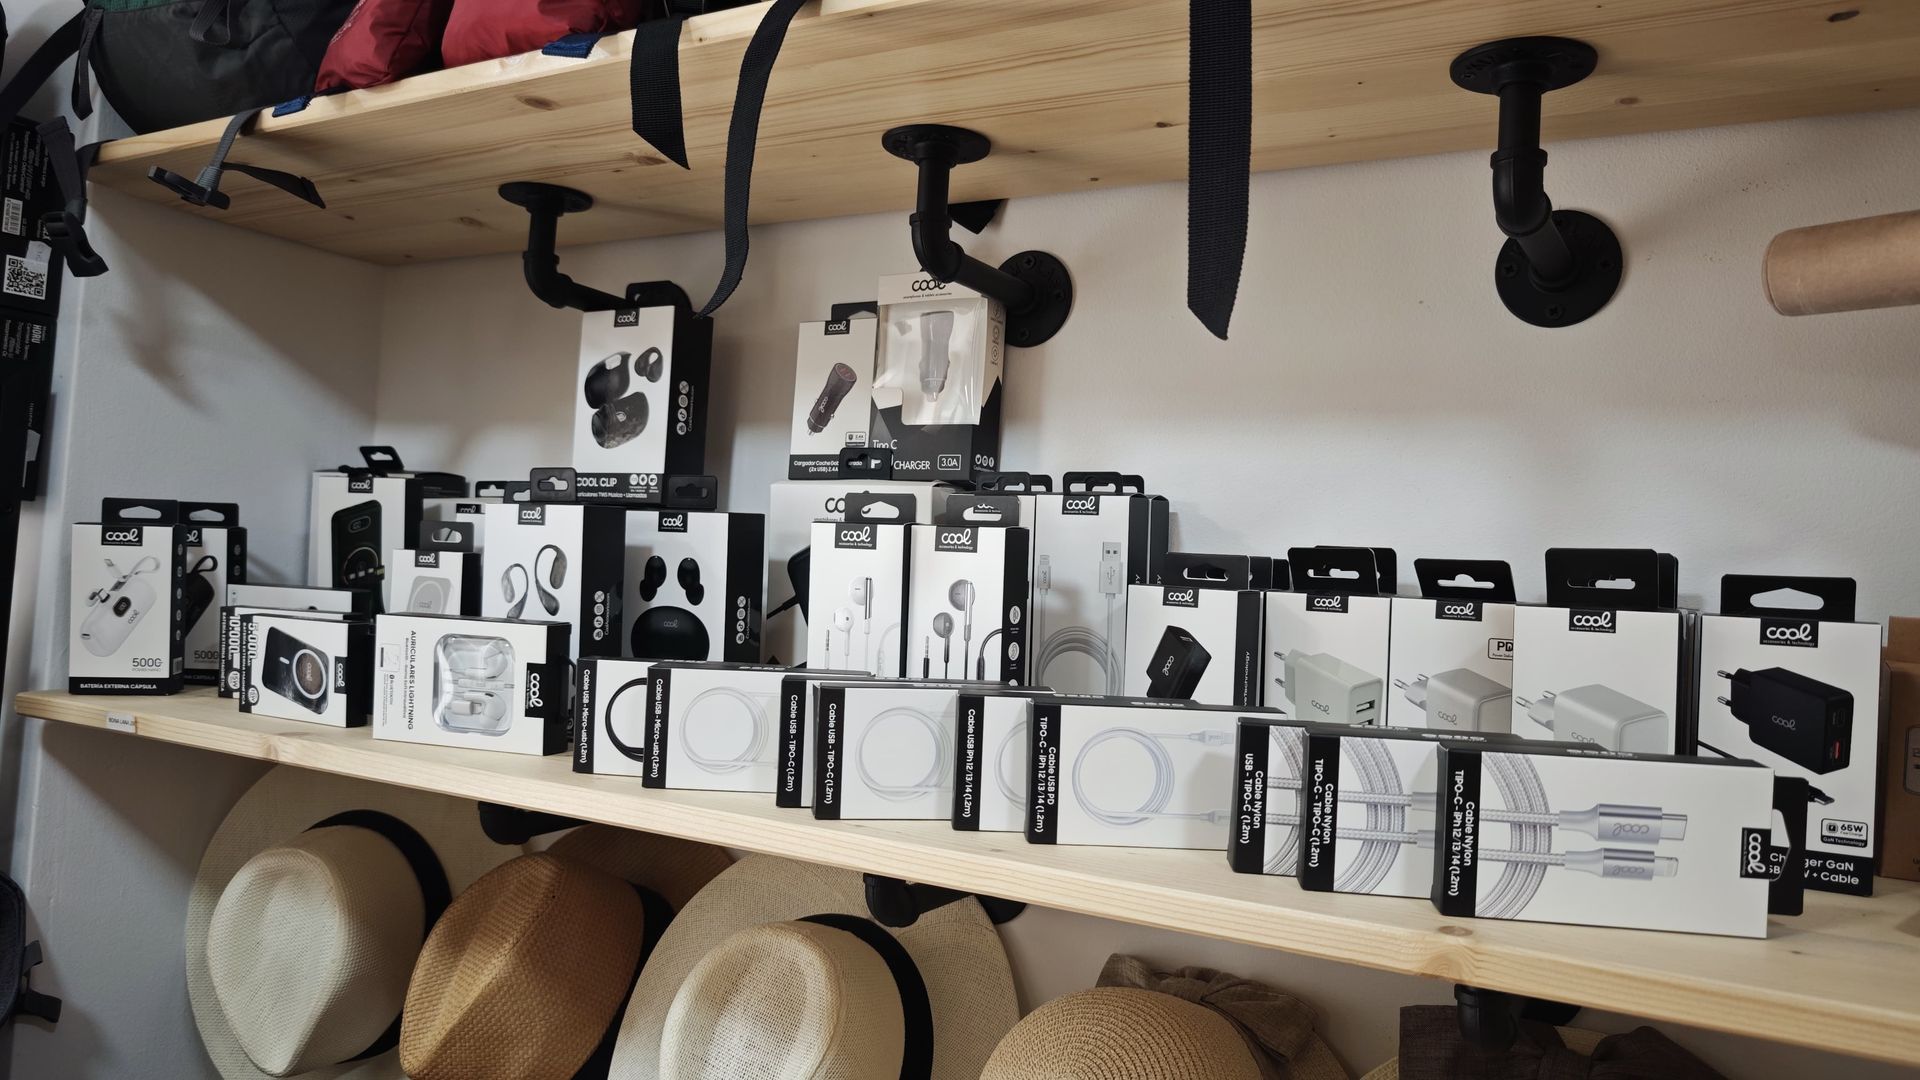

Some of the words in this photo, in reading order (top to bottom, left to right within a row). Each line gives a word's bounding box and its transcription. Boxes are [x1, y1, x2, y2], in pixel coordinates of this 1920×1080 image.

[617, 312, 637, 324] cool
[827, 320, 847, 332] cool
[893, 460, 930, 470] CHARGER
[941, 457, 958, 467] 3.0A
[351, 479, 371, 490] cool
[600, 477, 618, 487] CLIP
[521, 507, 542, 519] cool
[1066, 496, 1095, 510] cool
[662, 514, 684, 527] cool
[105, 528, 139, 542] cool
[841, 526, 871, 542] cool
[941, 528, 972, 545] cool
[418, 552, 436, 564] cool
[1168, 589, 1194, 602] cool
[1314, 595, 1341, 608] cool
[1444, 602, 1475, 616] cool
[1573, 611, 1612, 627] cool
[1766, 623, 1812, 641] cool
[337, 663, 345, 688] cool
[1162, 655, 1175, 676] cool
[529, 672, 543, 708] cool
[583, 669, 591, 690] Cable
[655, 679, 664, 701] Cable
[407, 685, 415, 730] LIGHTNING
[582, 690, 590, 704] USB
[790, 694, 798, 719] Cable
[1311, 700, 1330, 714] cool
[581, 707, 589, 742] Micro-usb
[789, 719, 797, 734] USB
[828, 703, 837, 729] Cable
[967, 708, 976, 734] Cable
[1437, 710, 1457, 725] cool
[1771, 714, 1796, 731] cool
[653, 719, 661, 756] Micro-usb
[827, 729, 836, 744] USB
[966, 734, 975, 749] USB
[1039, 716, 1048, 748] TIPO-C
[787, 739, 797, 767] TIPO-C
[1047, 746, 1057, 774] Cable
[1244, 753, 1254, 771] USB
[826, 750, 835, 778] TIPO-C
[785, 767, 795, 792] (1.2m)
[965, 762, 974, 793] 12/13/14
[1047, 775, 1056, 792] USB
[1254, 770, 1264, 800] Cable
[1313, 758, 1324, 793] TIPO-C
[823, 779, 834, 804] (1.2m)
[1037, 770, 1046, 804] 12/13/14
[1243, 778, 1253, 812] TIPO-C
[1453, 769, 1464, 805] TIPO-C
[962, 793, 972, 818] (1.2m)
[1046, 793, 1055, 805] PD
[1324, 783, 1334, 814] Cable
[1034, 805, 1045, 833] (1.2m)
[1251, 800, 1263, 829] Nylon
[1311, 801, 1322, 836] TIPO-C
[1464, 801, 1475, 834] Cable
[1239, 814, 1251, 844] (1.2m)
[1321, 815, 1333, 844] Nylon
[1612, 822, 1650, 837] cool
[1840, 823, 1864, 833] 65W
[1308, 836, 1320, 868] (1.2m)
[1451, 828, 1462, 865] 12/13/14
[1461, 835, 1474, 866] Nylon
[1835, 837, 1865, 847] Technology
[1747, 833, 1766, 874] cool
[1612, 865, 1645, 876] cool
[1825, 860, 1854, 871] GaN
[1448, 866, 1461, 896] (1.2m)
[1820, 871, 1859, 885] Cable
